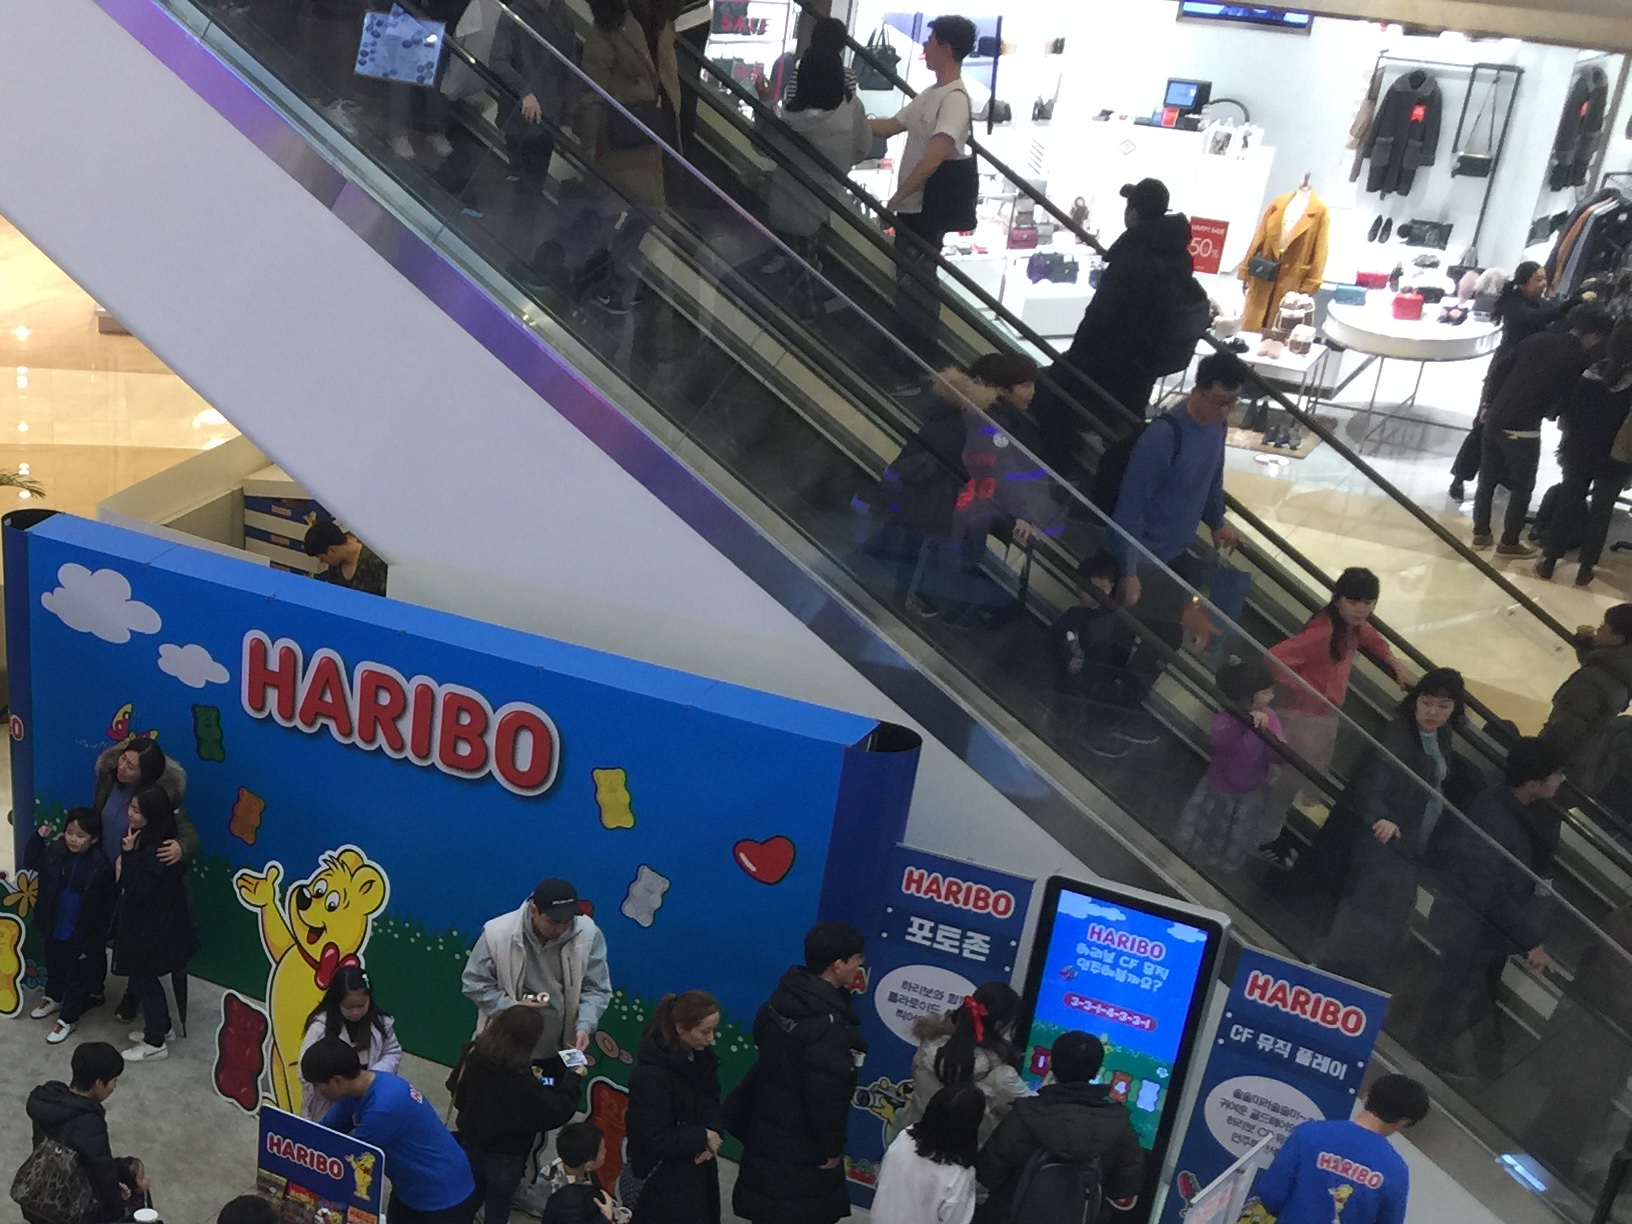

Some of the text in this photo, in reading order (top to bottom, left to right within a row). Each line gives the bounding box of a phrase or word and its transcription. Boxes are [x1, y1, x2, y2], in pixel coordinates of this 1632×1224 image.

[242, 630, 560, 795] HARIBO
[902, 866, 1015, 919] HARIBO
[904, 915, 992, 962] 포토존
[1087, 922, 1167, 961] HARIBO
[1119, 955, 1139, 969] CF
[901, 980, 945, 1001] 하리보와
[1244, 970, 1367, 1037] HARIBO
[1229, 1024, 1348, 1081] CF 뮤직 플레이
[1219, 1097, 1249, 1117] 귀여운
[267, 1131, 344, 1180] HARIBO
[1316, 1151, 1385, 1190] HARIBO
